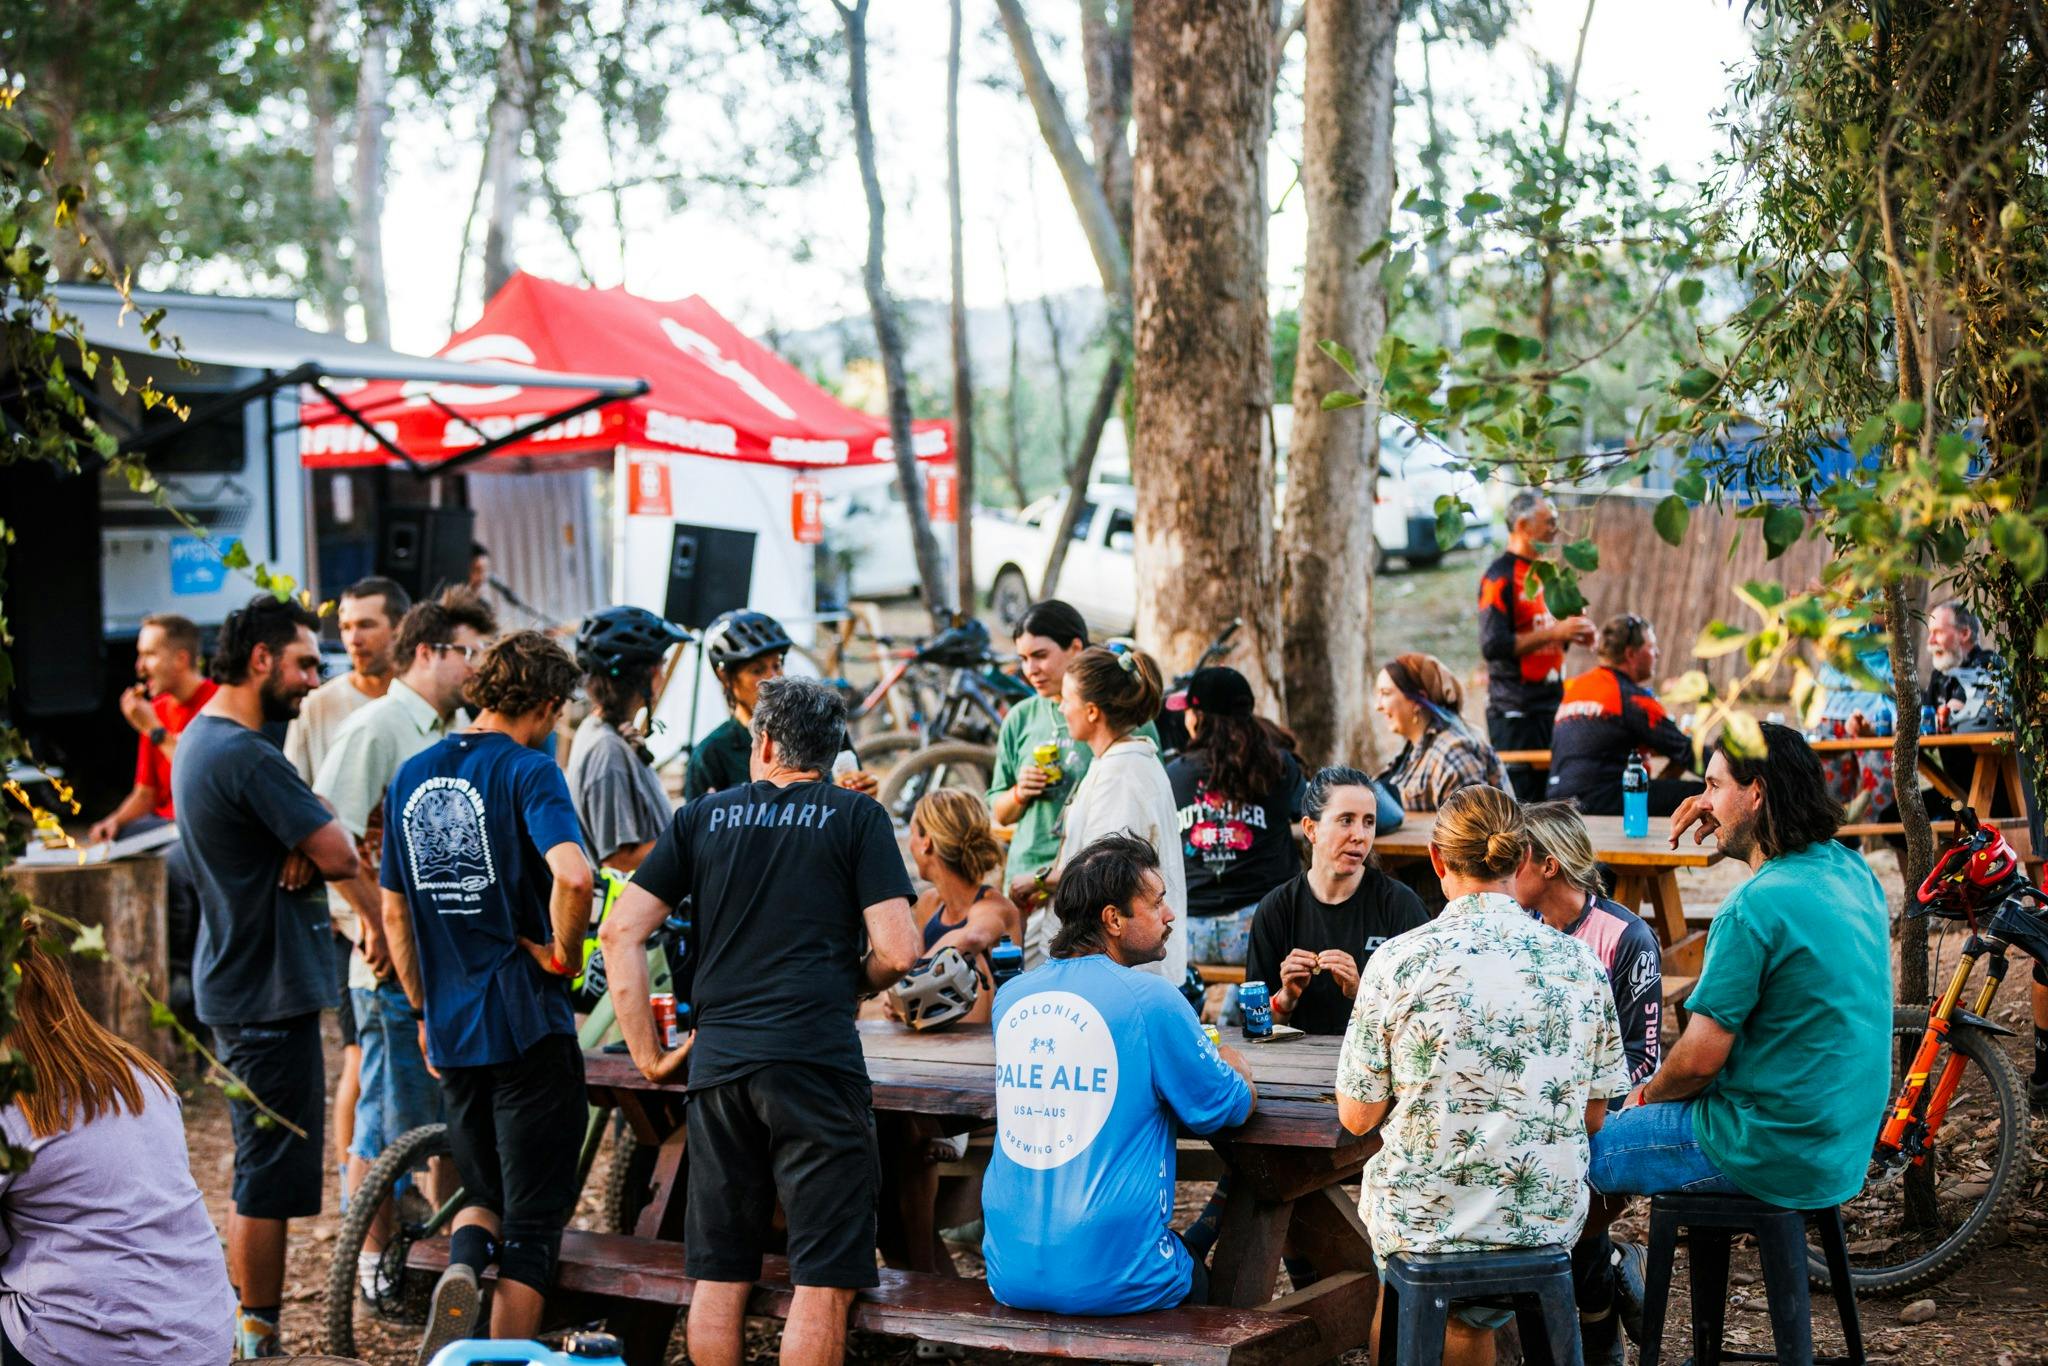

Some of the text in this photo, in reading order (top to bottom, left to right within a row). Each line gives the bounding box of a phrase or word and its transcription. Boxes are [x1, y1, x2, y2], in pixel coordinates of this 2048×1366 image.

[709, 802, 836, 832] PRIMARY
[1176, 799, 1267, 833] UTER
[1009, 1003, 1088, 1033] COLONIAL
[1645, 1001, 1659, 1057] GIRLS
[997, 1063, 1108, 1093] PALE ALE
[1006, 1129, 1052, 1155] BREWING
